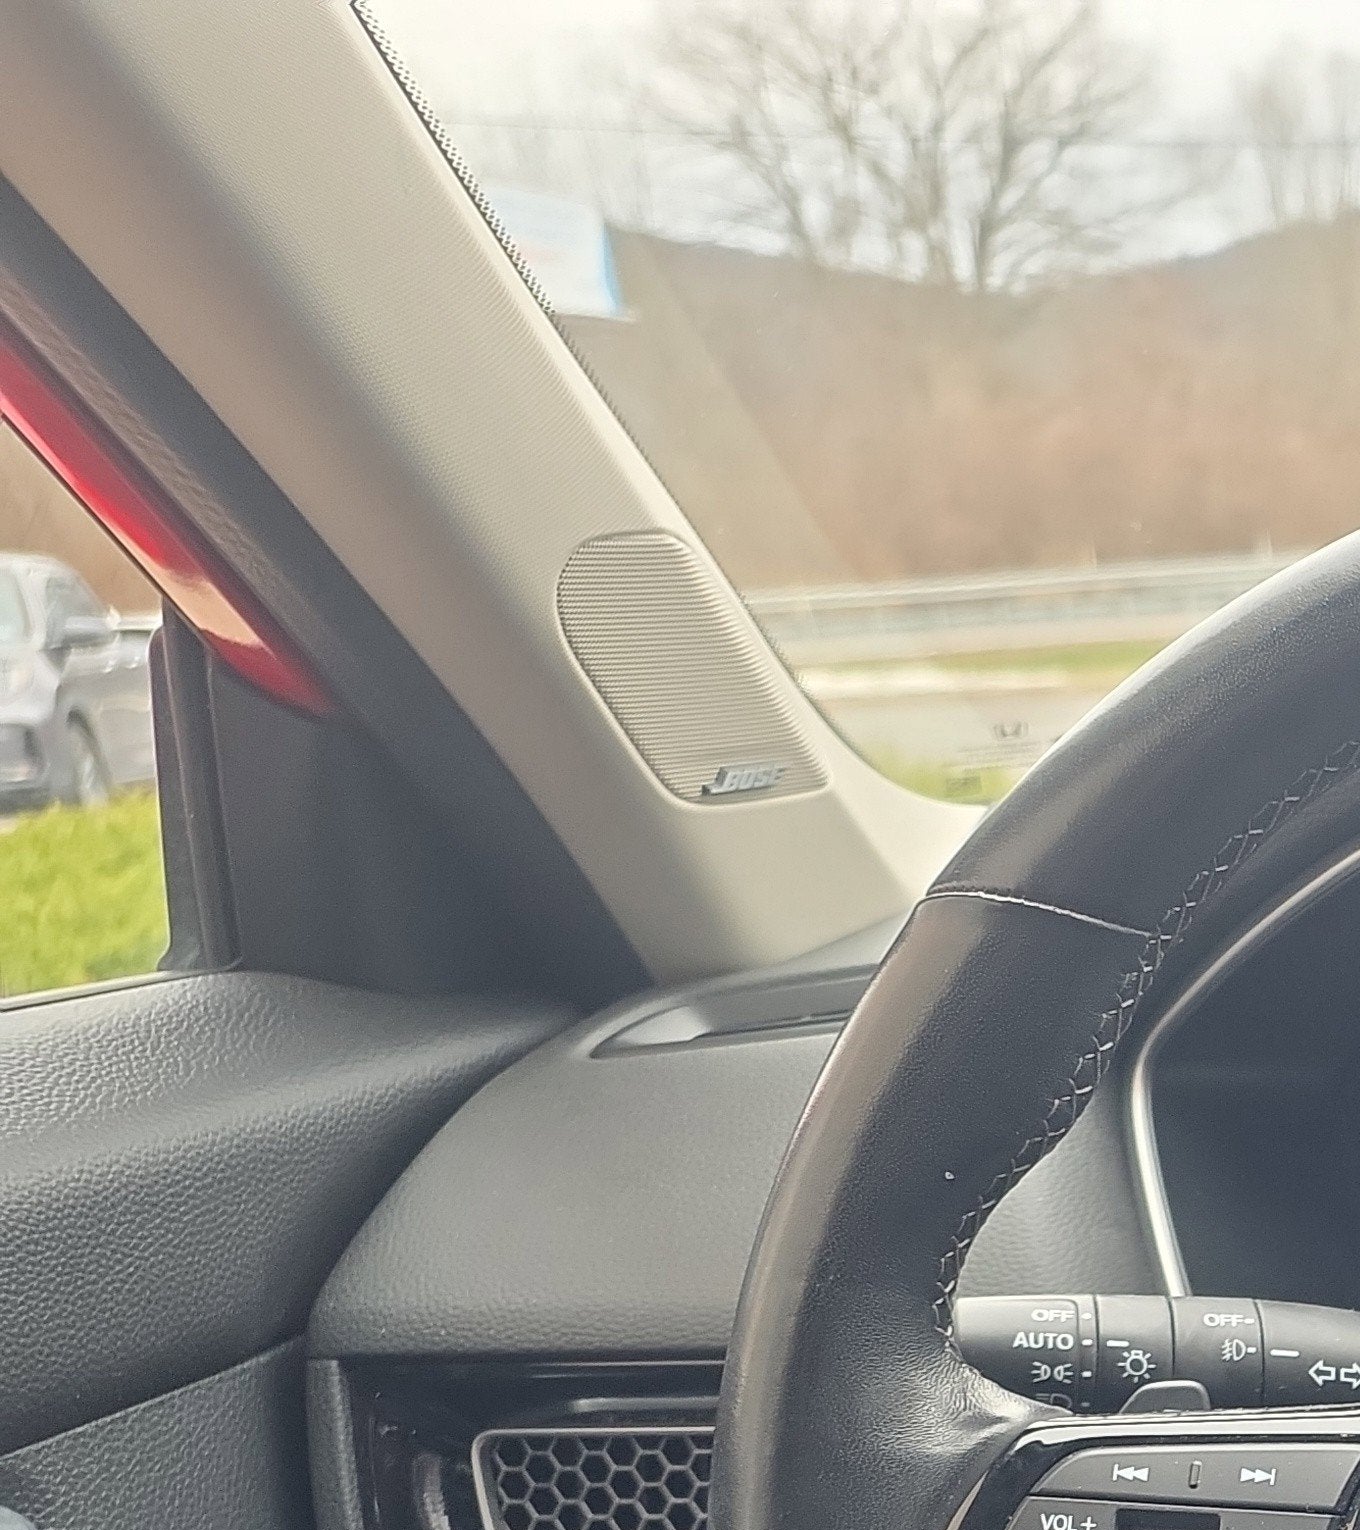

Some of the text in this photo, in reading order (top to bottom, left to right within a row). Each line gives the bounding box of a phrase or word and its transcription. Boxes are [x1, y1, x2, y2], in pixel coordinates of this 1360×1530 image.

[1031, 1309, 1074, 1323] OFF
[1203, 1313, 1244, 1328] OFF
[1013, 1333, 1074, 1351] AUTO
